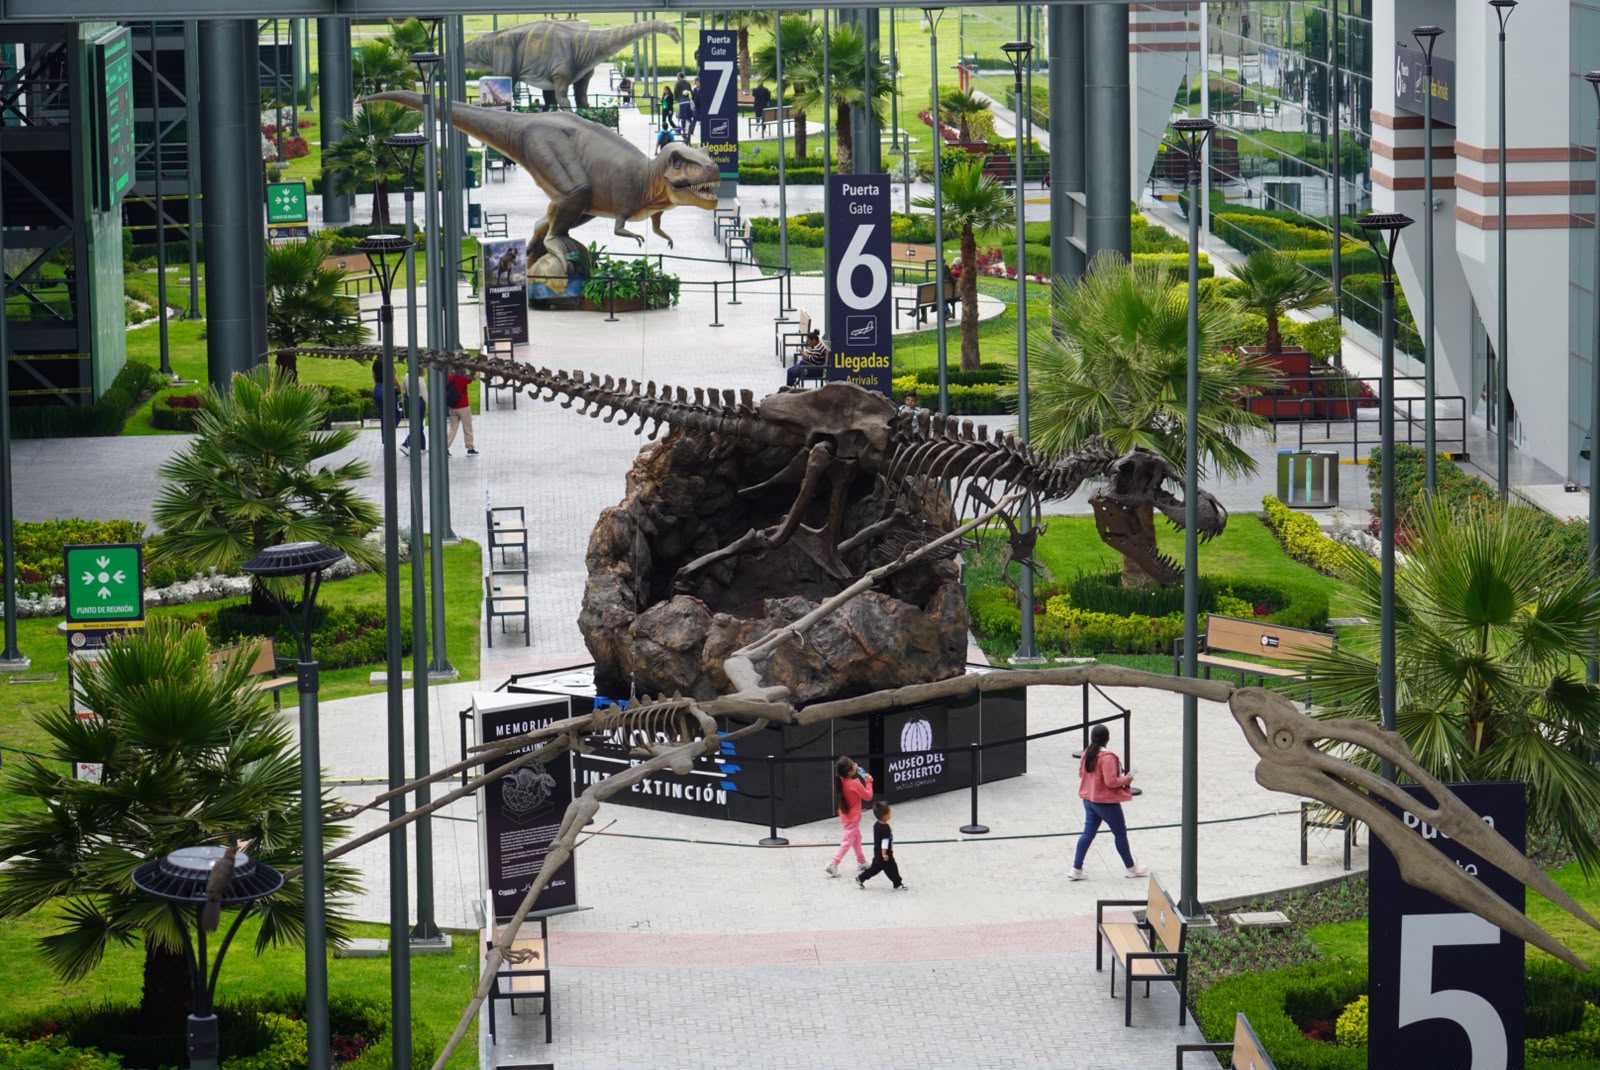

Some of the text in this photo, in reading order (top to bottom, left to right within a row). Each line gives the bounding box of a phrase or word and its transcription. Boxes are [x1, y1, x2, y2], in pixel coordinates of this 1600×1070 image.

[707, 36, 730, 44] Puerta
[711, 47, 727, 55] Gate
[1397, 55, 1401, 97] 6
[704, 61, 733, 115] 7
[842, 184, 879, 196] Puerta
[849, 202, 873, 214] Gate
[836, 224, 888, 310] 6
[834, 352, 890, 372] Llegadas
[846, 374, 878, 385] Arrivals
[76, 604, 133, 614] PUNTO DE REUNIÓN
[888, 753, 944, 773] MUSEO DEL
[894, 764, 942, 783] DESIERTO
[632, 778, 727, 805] EXTINCIÓN
[1398, 912, 1508, 1070] 5
